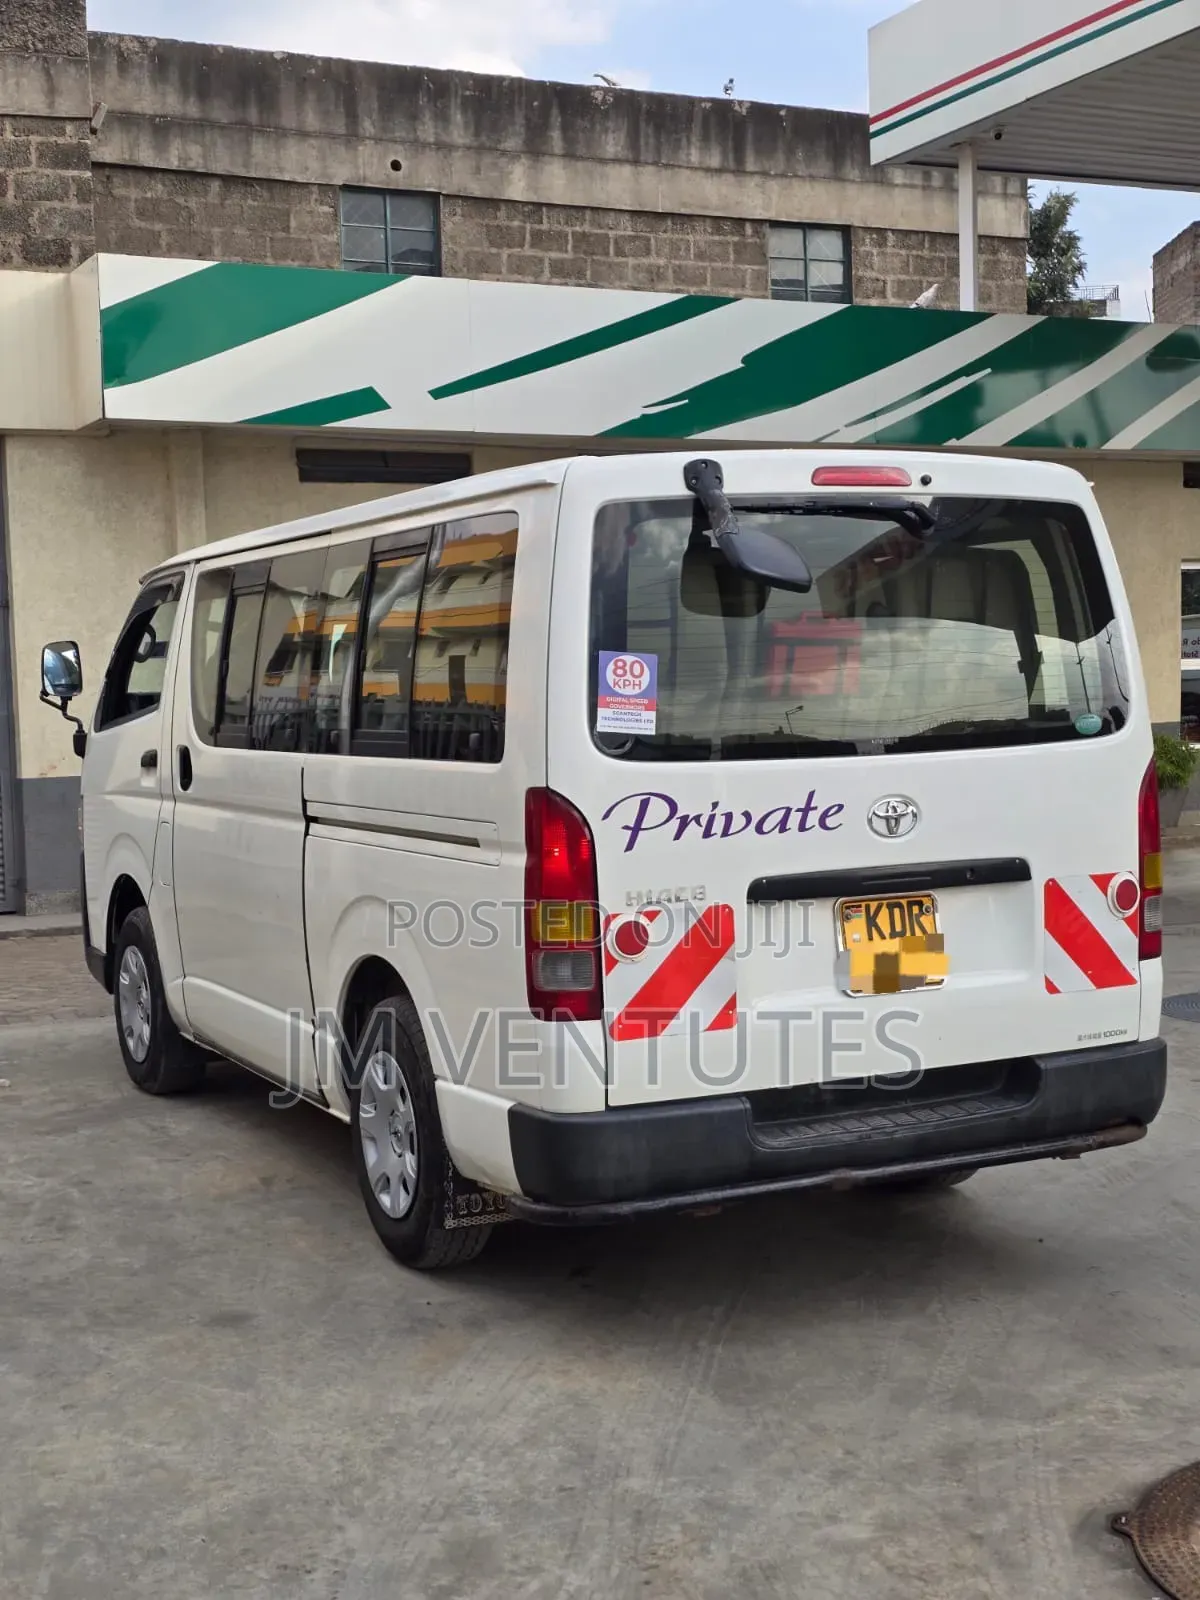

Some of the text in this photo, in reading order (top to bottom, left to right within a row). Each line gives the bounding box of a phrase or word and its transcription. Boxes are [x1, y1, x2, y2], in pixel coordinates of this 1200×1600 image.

[612, 658, 645, 679] 80
[613, 678, 642, 690] KPH
[606, 696, 629, 704] DIGITAL
[601, 788, 845, 853] Private
[865, 899, 928, 942] KDR
